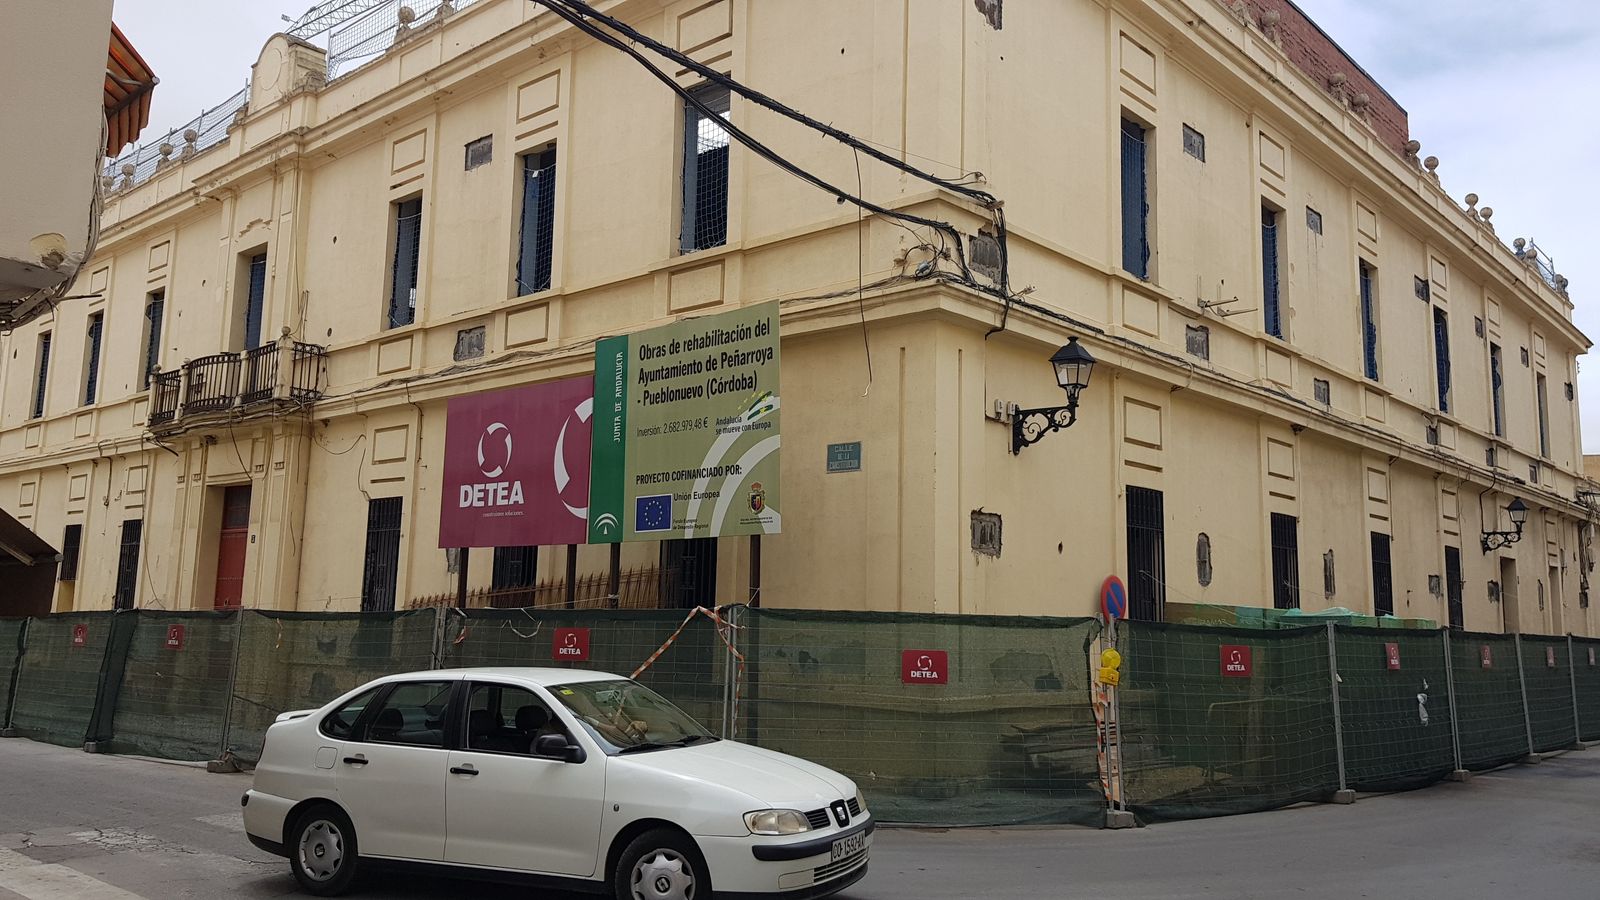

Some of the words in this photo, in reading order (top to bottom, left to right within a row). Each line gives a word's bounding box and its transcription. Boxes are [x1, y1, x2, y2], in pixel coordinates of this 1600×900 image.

[639, 341, 667, 361] Obras
[669, 338, 681, 355] de
[683, 323, 751, 353] rehabilitación
[754, 317, 770, 337] del
[638, 360, 703, 387] Ayuntamiento
[705, 354, 718, 371] de
[721, 346, 773, 369] Peñarroya
[643, 383, 703, 407] Pueblonuevo
[706, 370, 758, 400] (Córdoba)
[614, 401, 622, 412] DE
[613, 415, 622, 443] JUNTA
[636, 425, 663, 437] Inversión:
[663, 418, 702, 434] 2.682.979,48
[703, 416, 709, 428] €
[715, 415, 742, 426] Andalucía
[722, 425, 741, 434] mueve
[741, 424, 752, 432] con
[752, 420, 772, 431] Europa
[636, 471, 670, 485] PROYECTO
[671, 466, 724, 482] COFINANCIADO
[725, 464, 742, 476] POR:
[459, 480, 525, 508] DETEA
[673, 491, 692, 502] Unión
[693, 490, 720, 501] Europea
[559, 647, 581, 655] DETEA
[910, 670, 939, 679] DETEA
